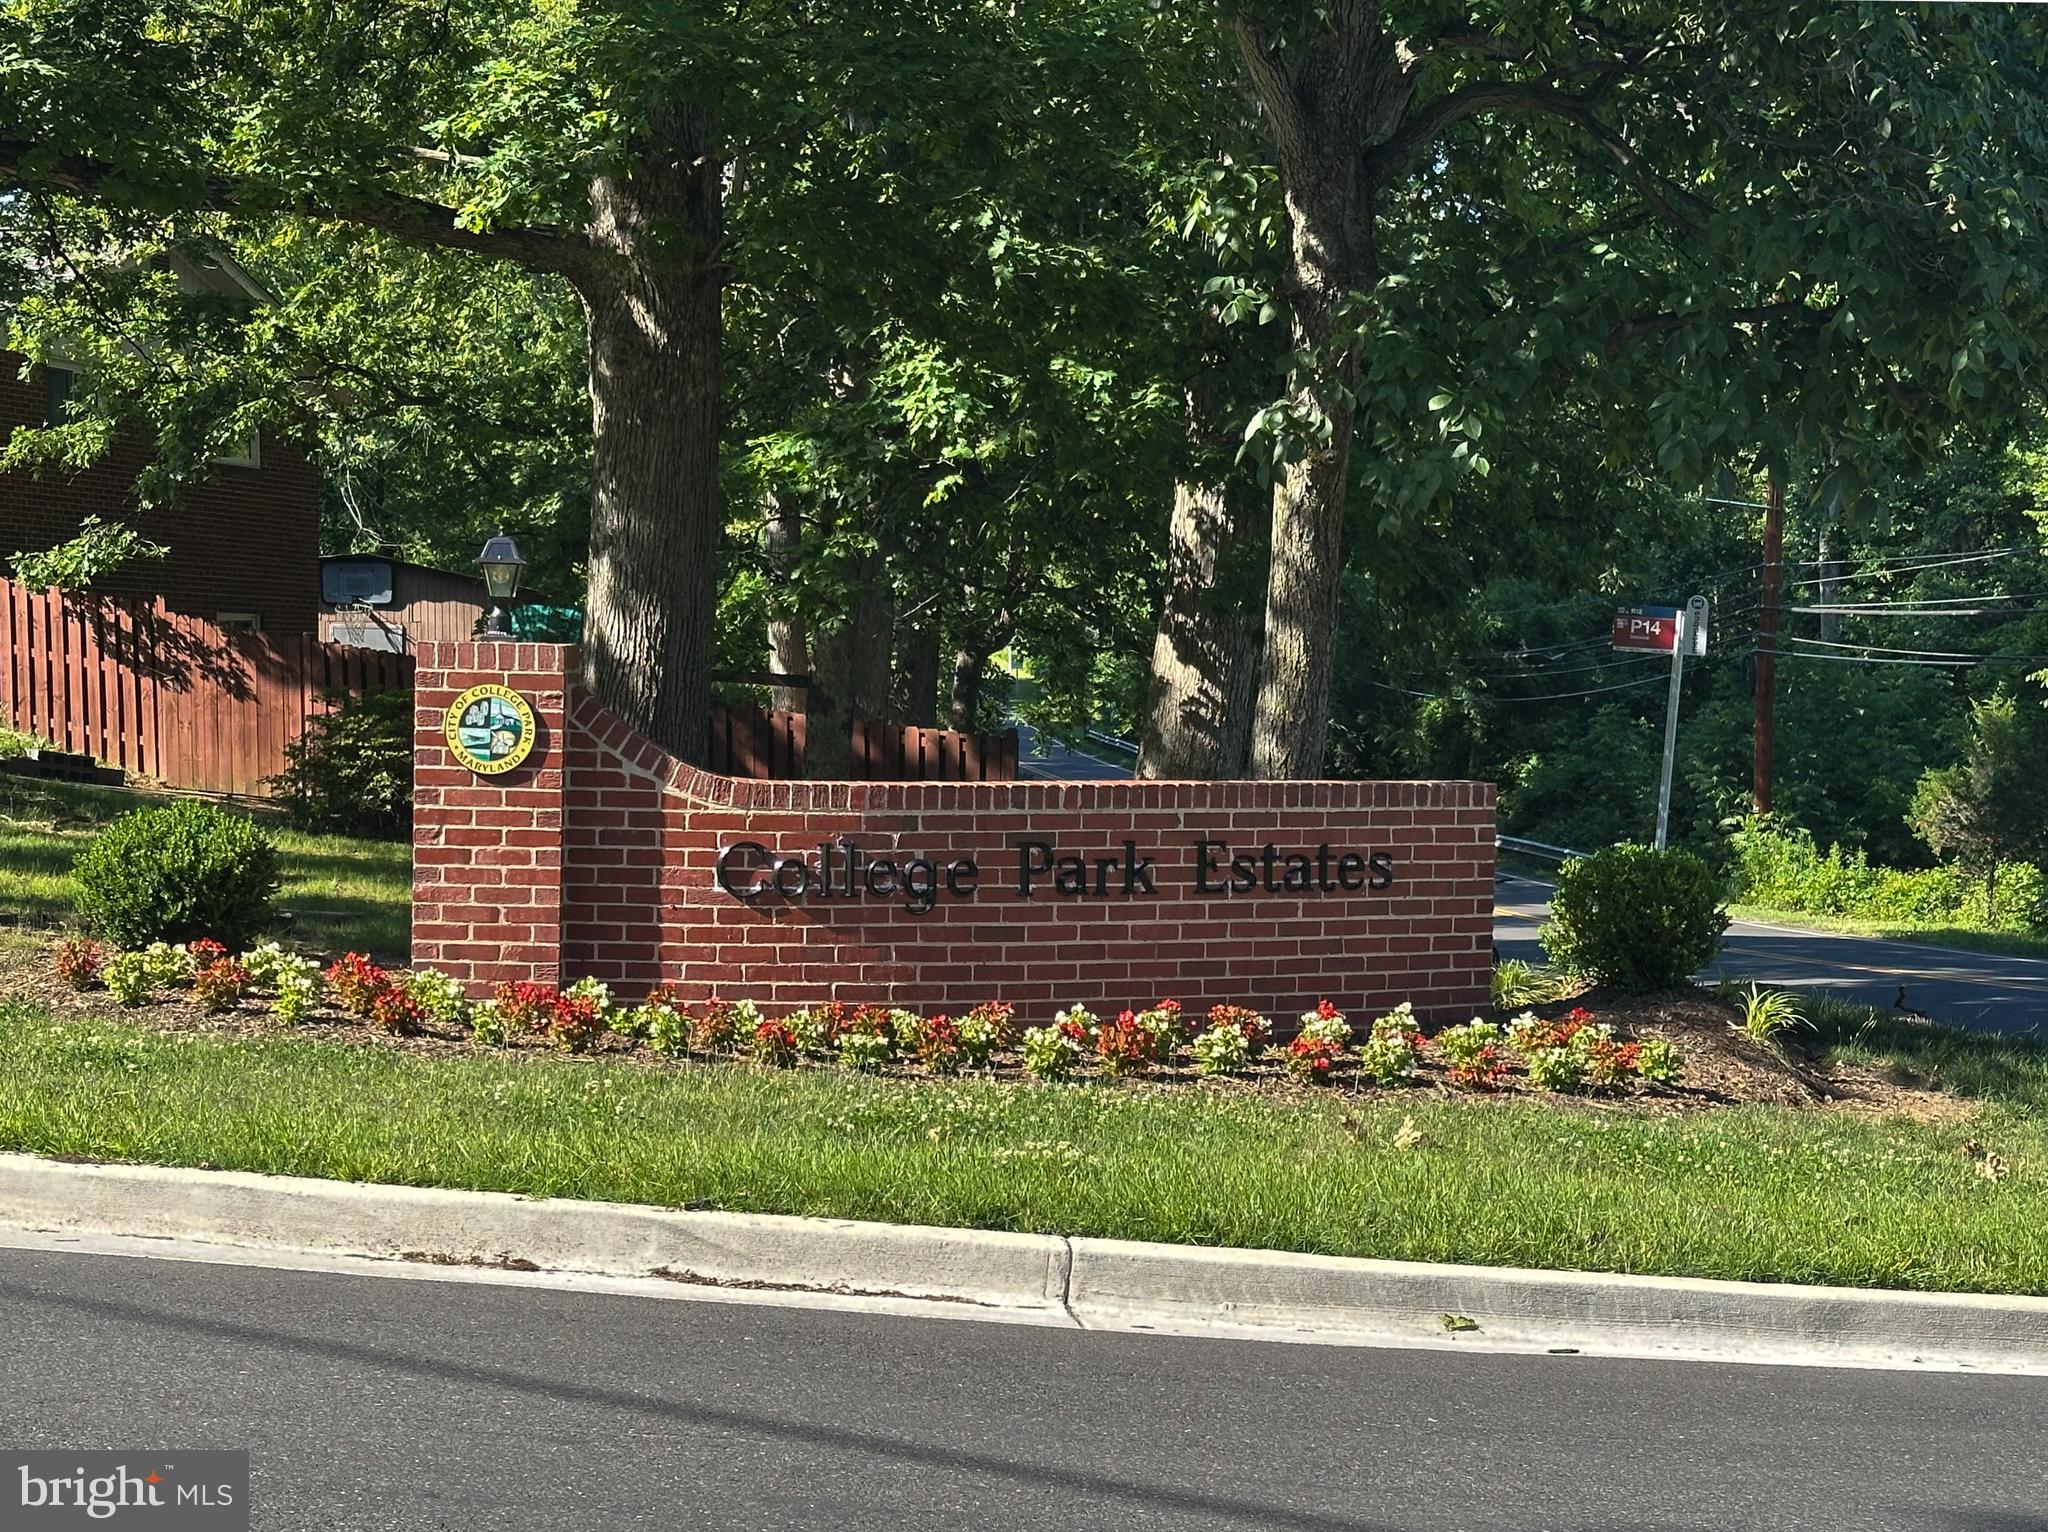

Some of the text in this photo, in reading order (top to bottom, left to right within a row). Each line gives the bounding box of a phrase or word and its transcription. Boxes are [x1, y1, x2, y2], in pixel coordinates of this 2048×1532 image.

[1630, 619, 1662, 635] P14
[448, 686, 533, 746] CITY OF COLLEGE PARK
[456, 751, 521, 773] MARYLAND
[717, 839, 1394, 915] College Park Estates
